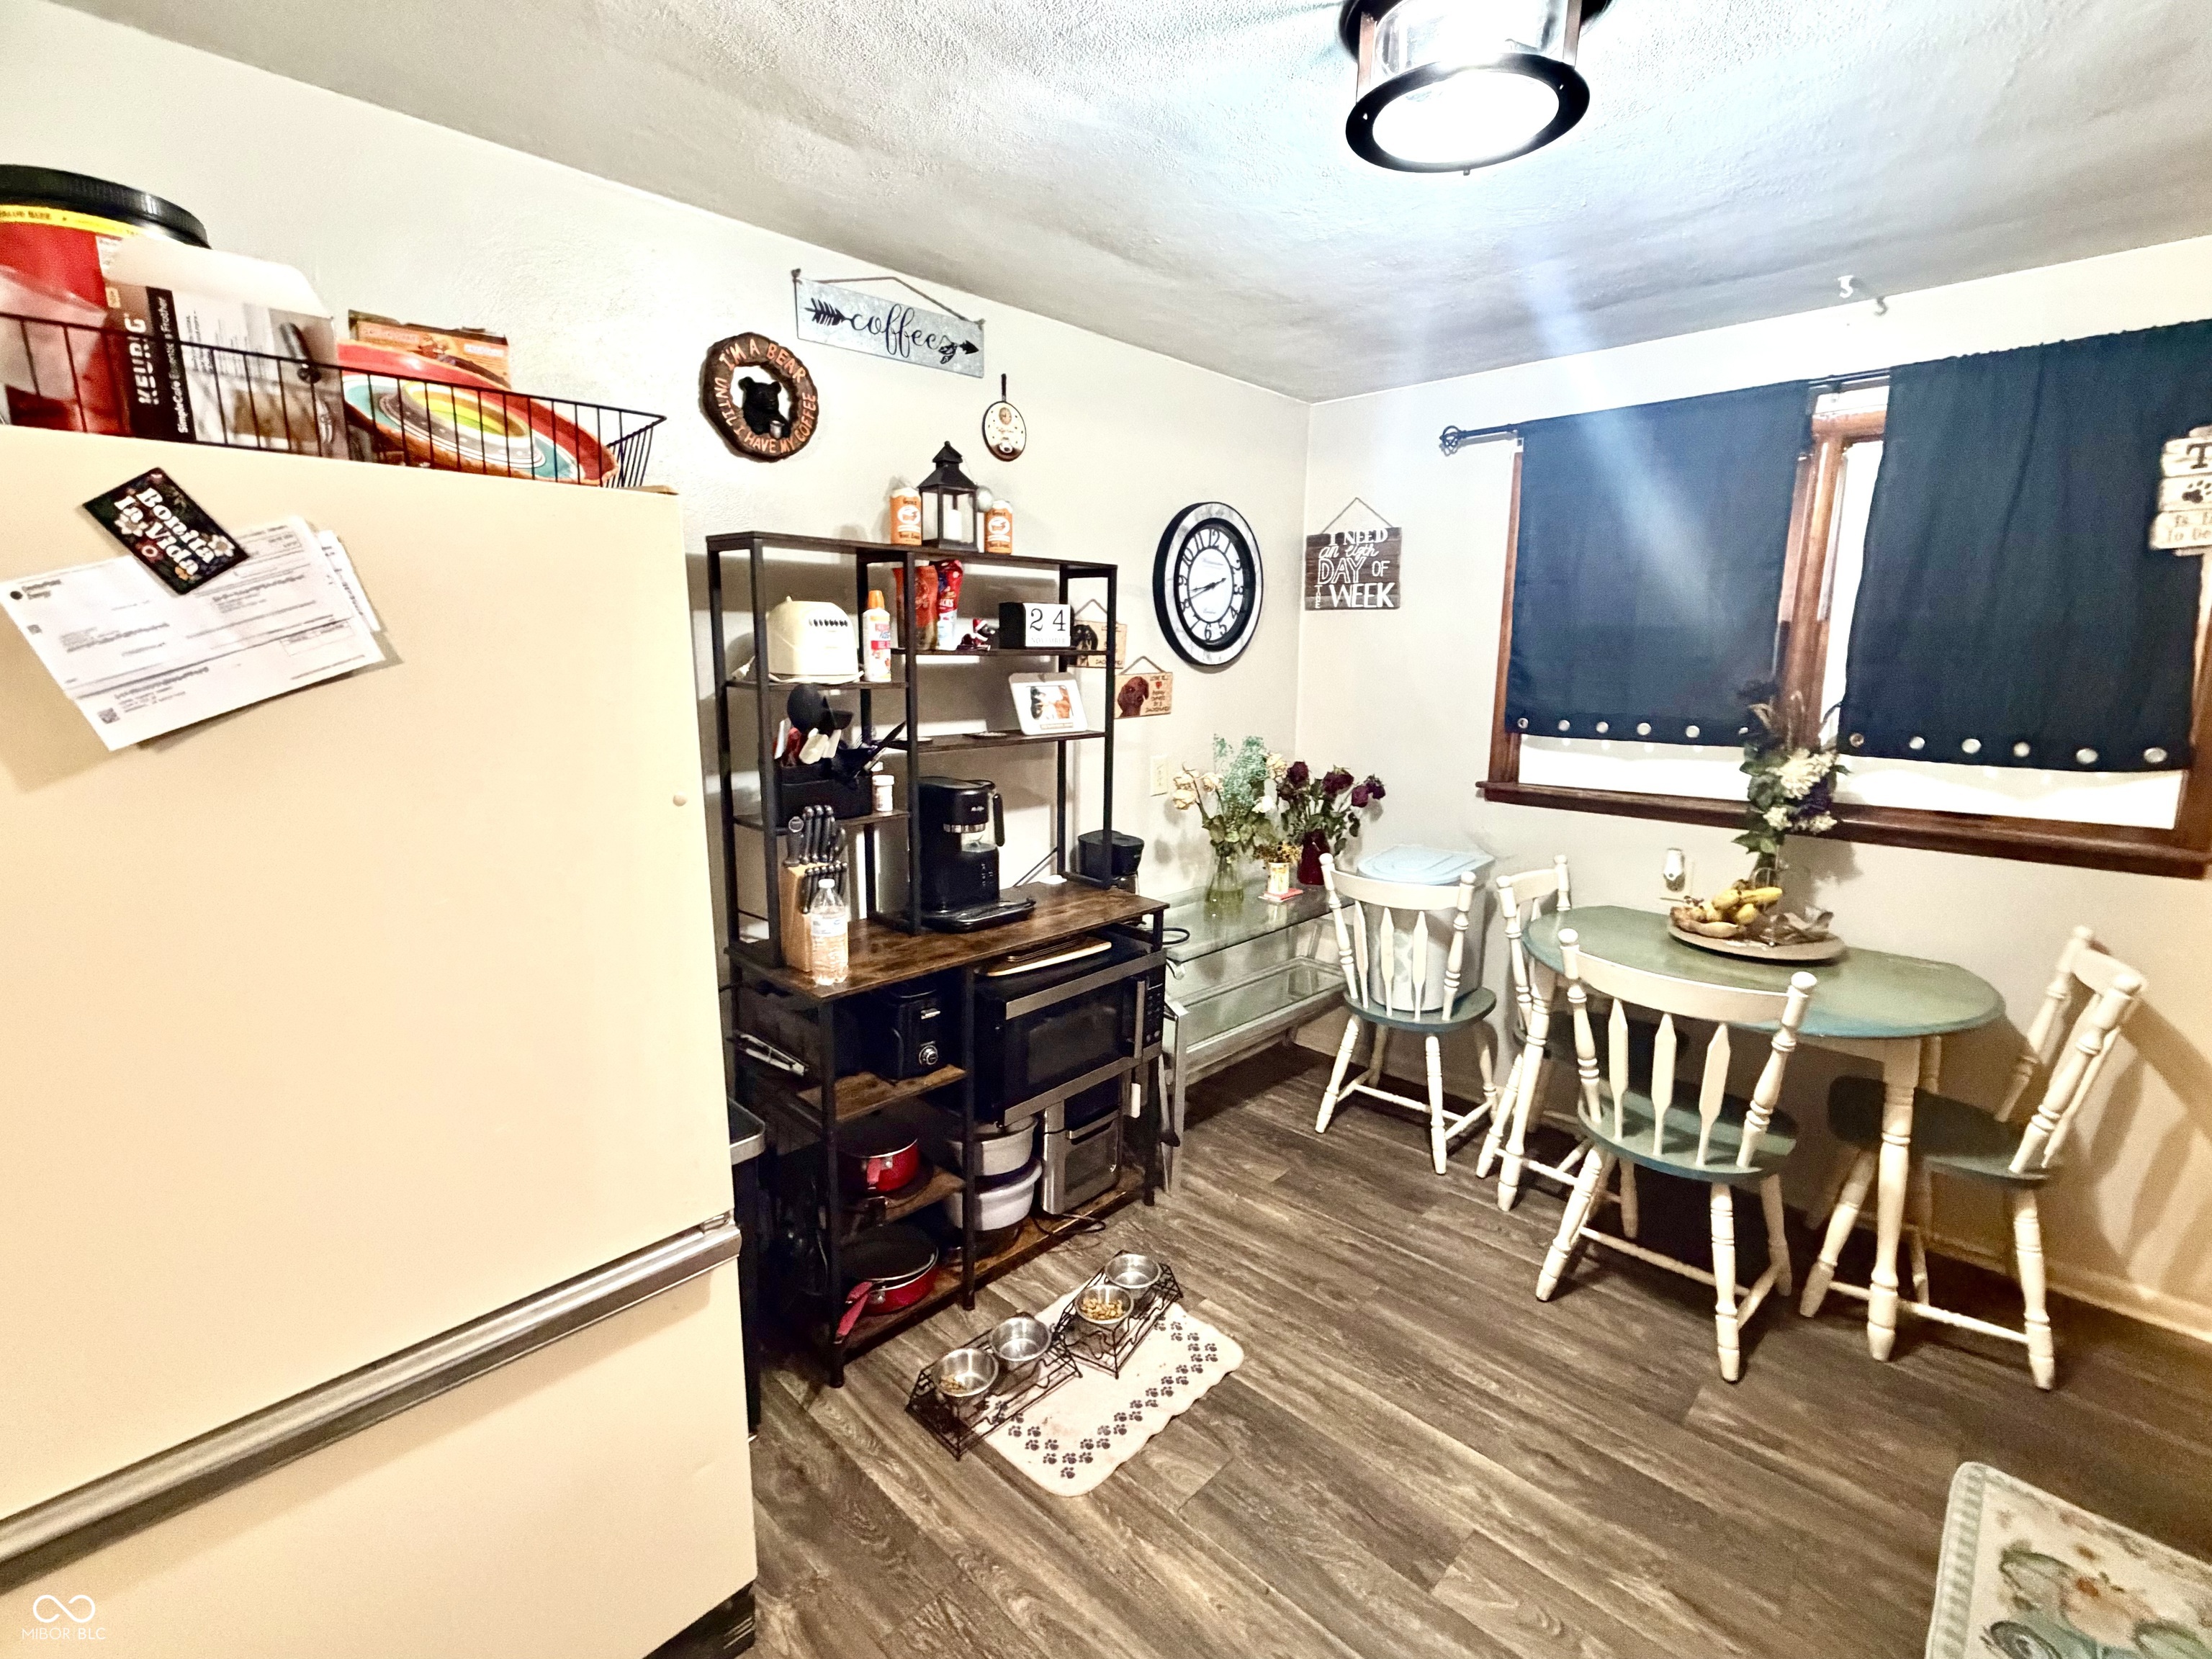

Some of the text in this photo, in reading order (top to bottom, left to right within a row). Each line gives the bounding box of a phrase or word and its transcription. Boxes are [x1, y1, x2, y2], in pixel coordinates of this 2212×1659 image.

[850, 303, 940, 359] coffee
[125, 314, 159, 405] KEURIG
[719, 339, 806, 383] I'M A BEAR
[714, 377, 737, 426] UNTIL
[744, 435, 776, 454] HAVE
[780, 439, 795, 453] MY
[794, 392, 817, 442] COFFEE
[114, 495, 199, 575] la Vida
[136, 487, 215, 563] Bonita
[1328, 529, 1388, 546] I NEED
[1209, 529, 1220, 549] 12
[1182, 547, 1194, 566] 10
[1318, 546, 1339, 558] an
[1179, 575, 1188, 586] 9
[1318, 557, 1391, 585] DAY OF
[1233, 584, 1244, 595] 3
[1314, 583, 1395, 608] THE WEEK
[1204, 622, 1213, 642] 6
